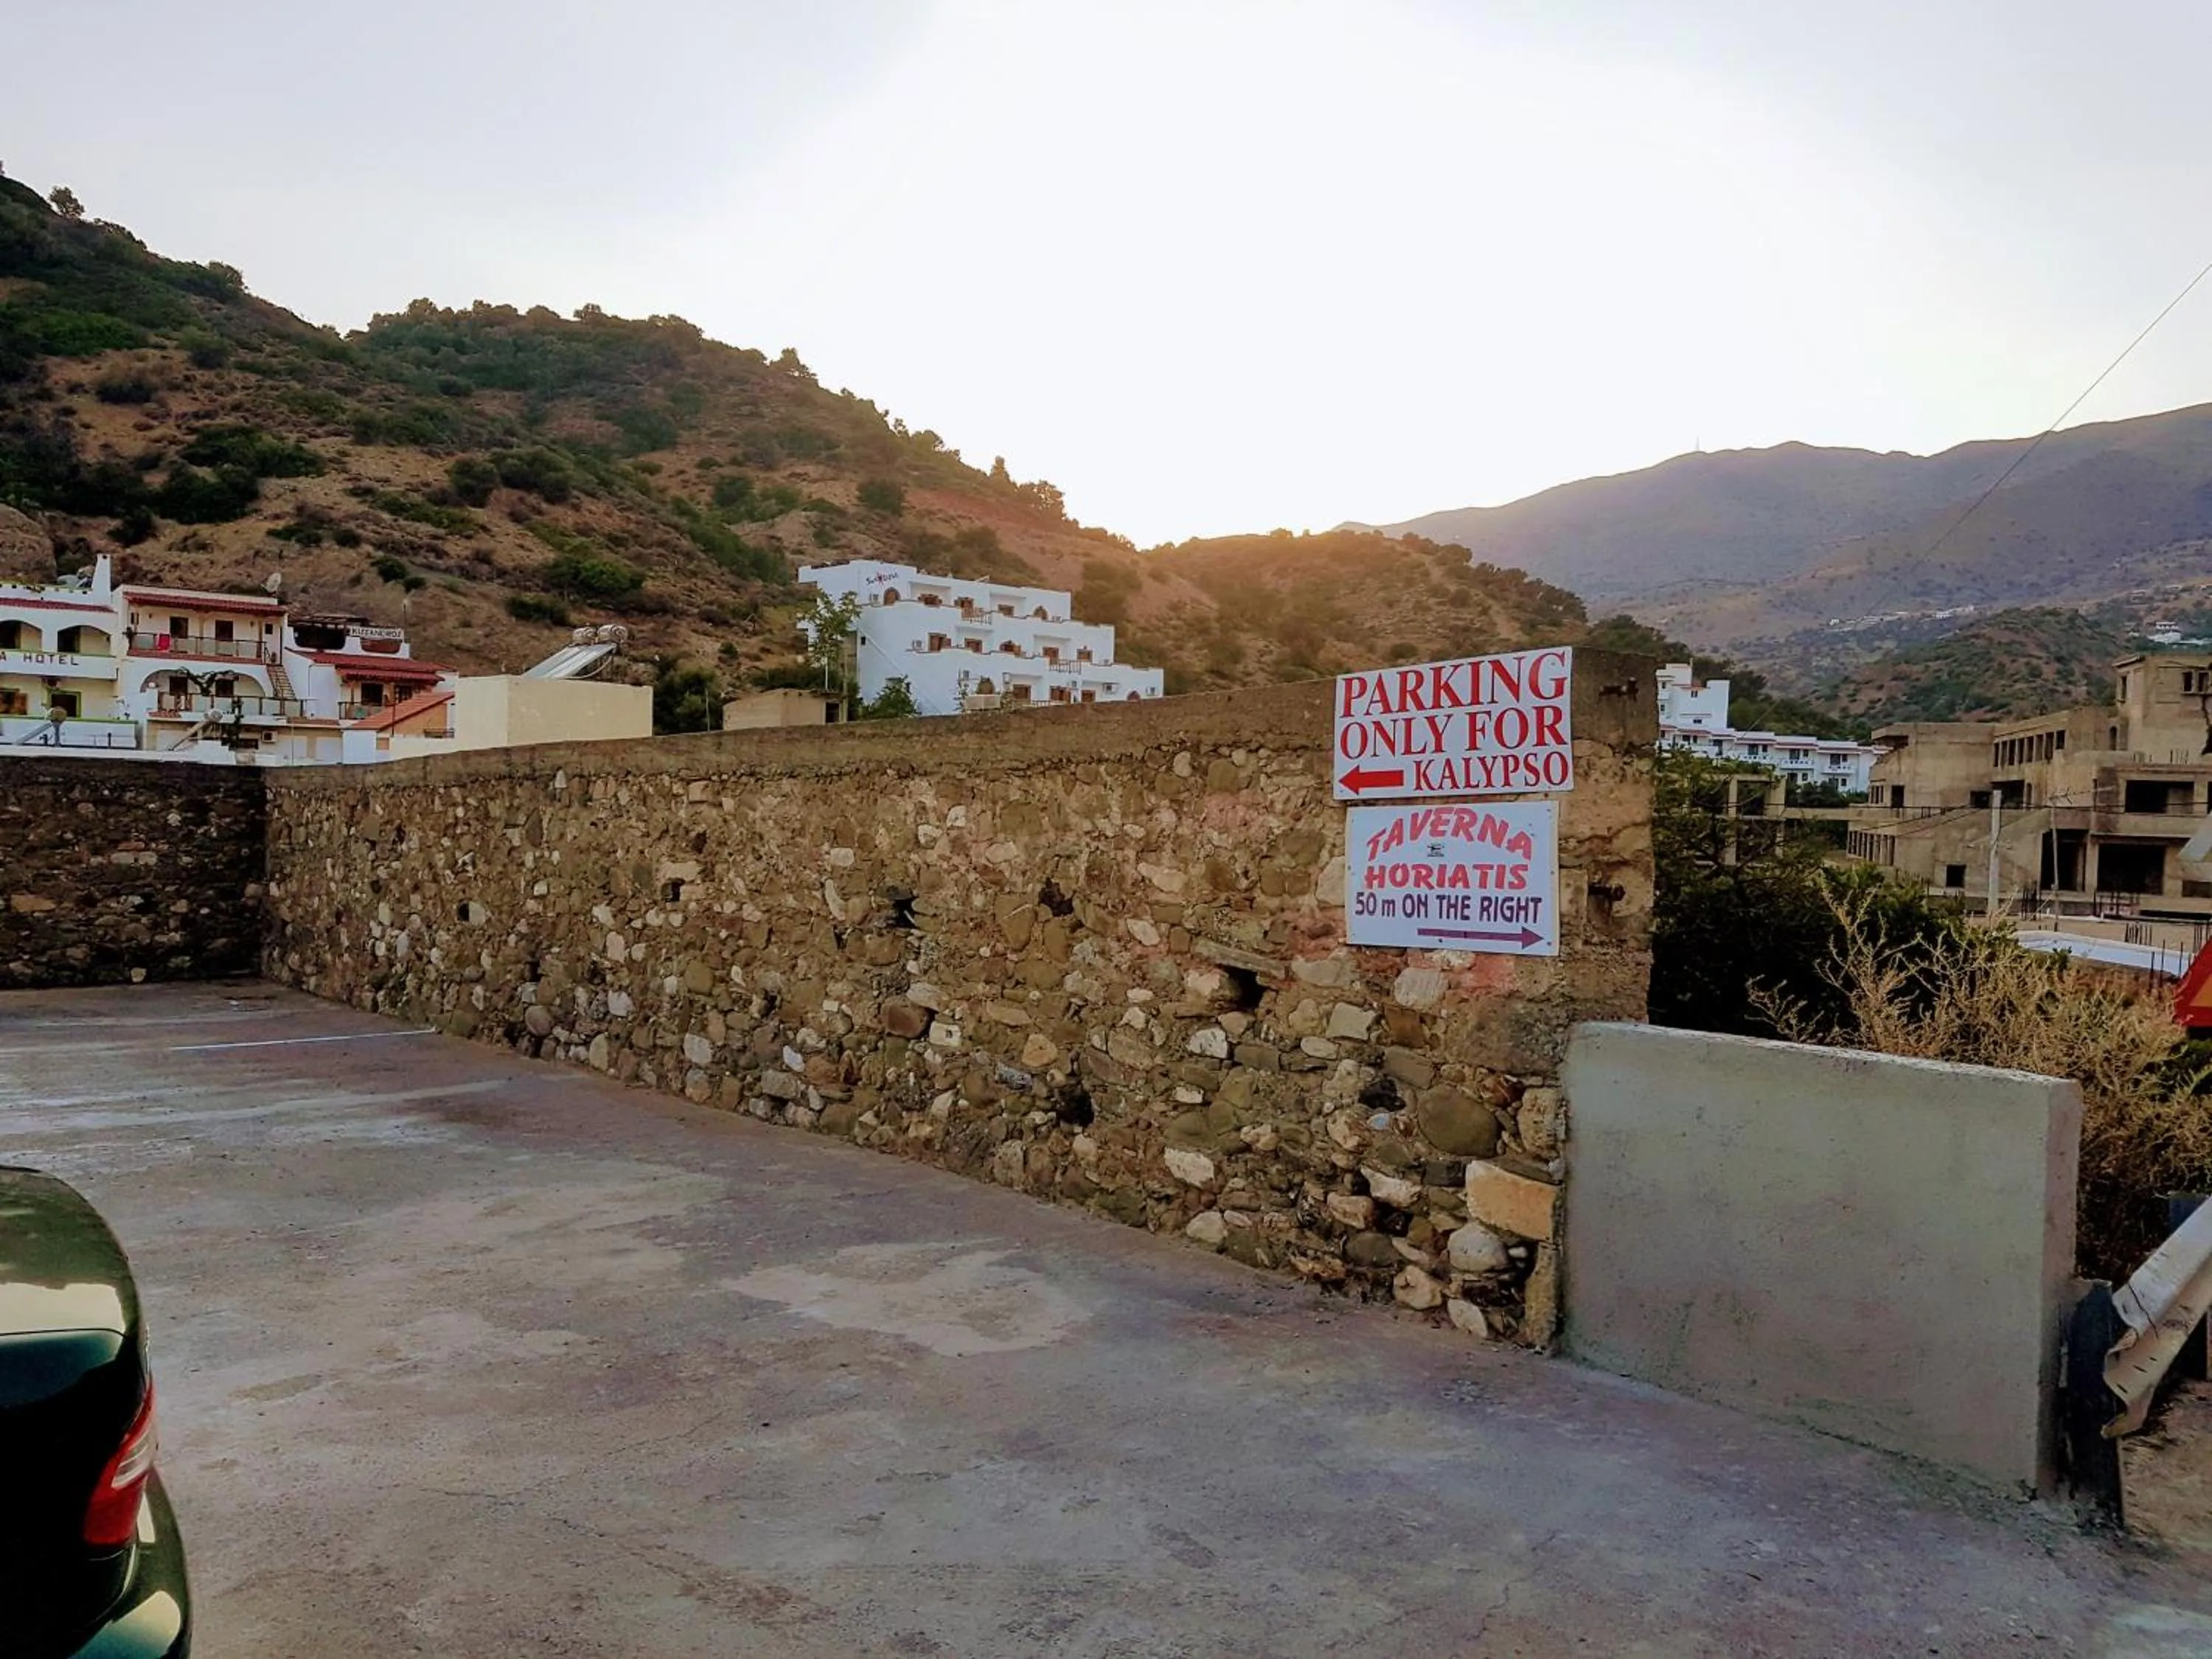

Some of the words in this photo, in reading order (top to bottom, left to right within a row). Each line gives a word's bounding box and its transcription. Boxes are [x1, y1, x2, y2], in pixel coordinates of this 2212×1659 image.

[23, 653, 80, 666] HOTEL
[1339, 651, 1568, 719] PARKING
[1340, 713, 1453, 759] ONLY
[1464, 705, 1568, 751] FOR
[1413, 751, 1568, 791] KALYPSO
[1366, 807, 1533, 862] TAVERNA
[1365, 863, 1529, 891] HORIATIS
[1354, 891, 1377, 917] 50
[1381, 897, 1396, 917] m
[1402, 893, 1428, 919] ON
[1436, 894, 1472, 921] THE
[1479, 896, 1543, 924] RIGHT
